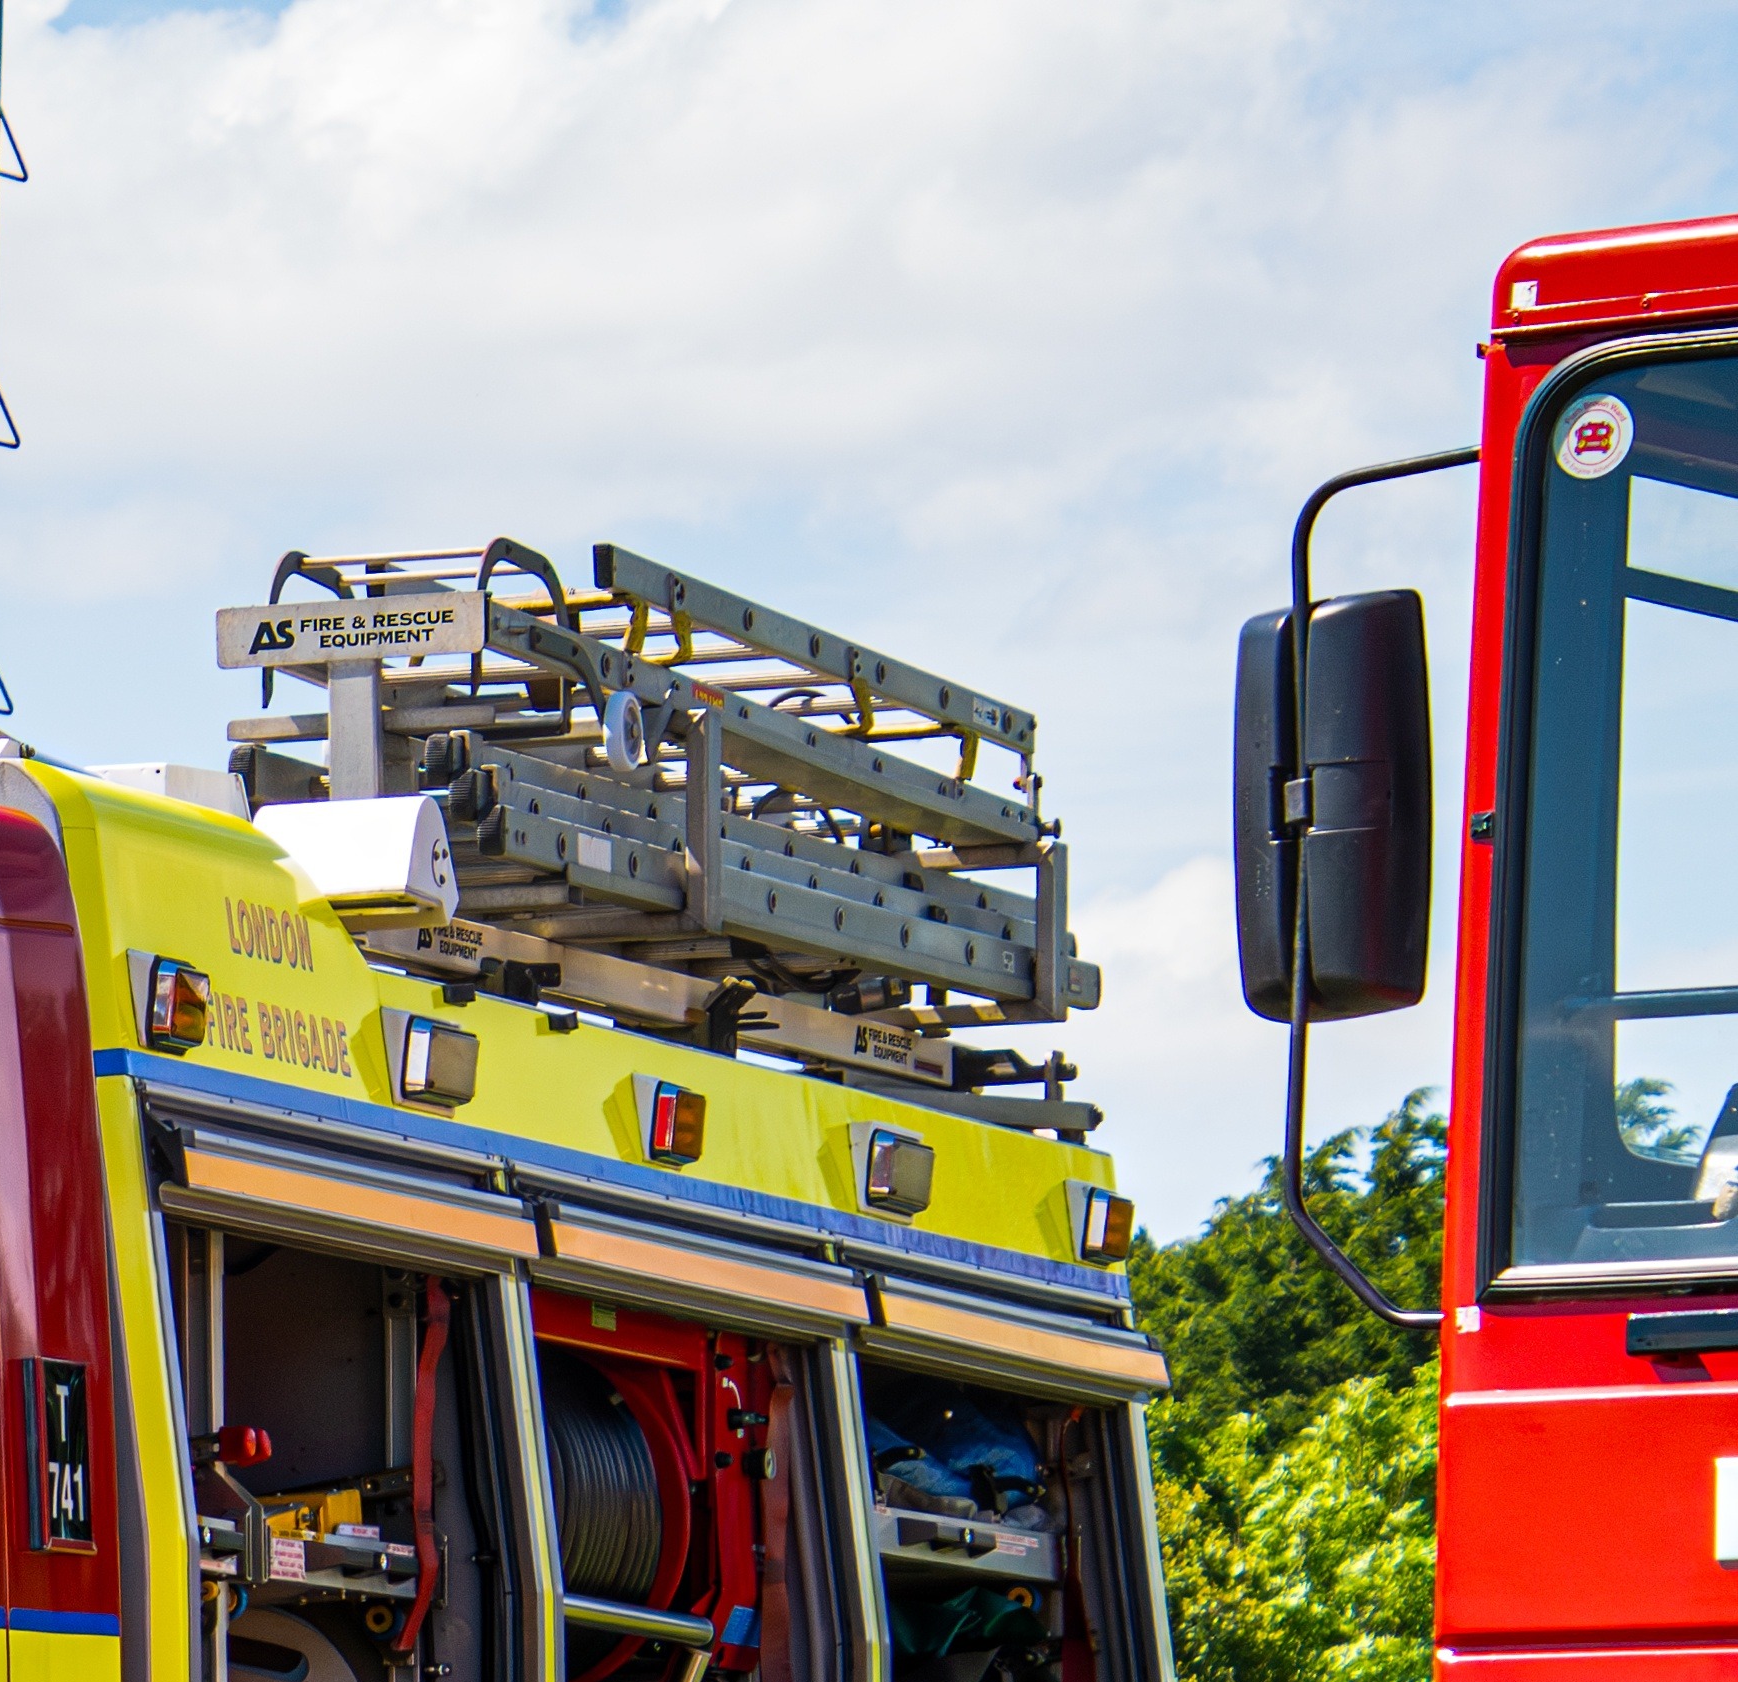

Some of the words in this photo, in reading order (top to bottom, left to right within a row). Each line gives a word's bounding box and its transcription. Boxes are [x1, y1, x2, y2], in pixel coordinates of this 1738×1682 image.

[248, 619, 295, 655] AS
[300, 617, 345, 633] FIRE
[352, 617, 365, 629] &
[373, 609, 454, 628] RESCUE
[319, 628, 435, 649] EQUIPMENT
[225, 896, 314, 973] LONDON
[439, 940, 477, 960] EQUIPMENT
[456, 927, 483, 946] RESCUE
[257, 1001, 352, 1077] BRIGADE
[854, 1025, 868, 1054] AS
[56, 1384, 69, 1442] T
[49, 1462, 84, 1521] 741
